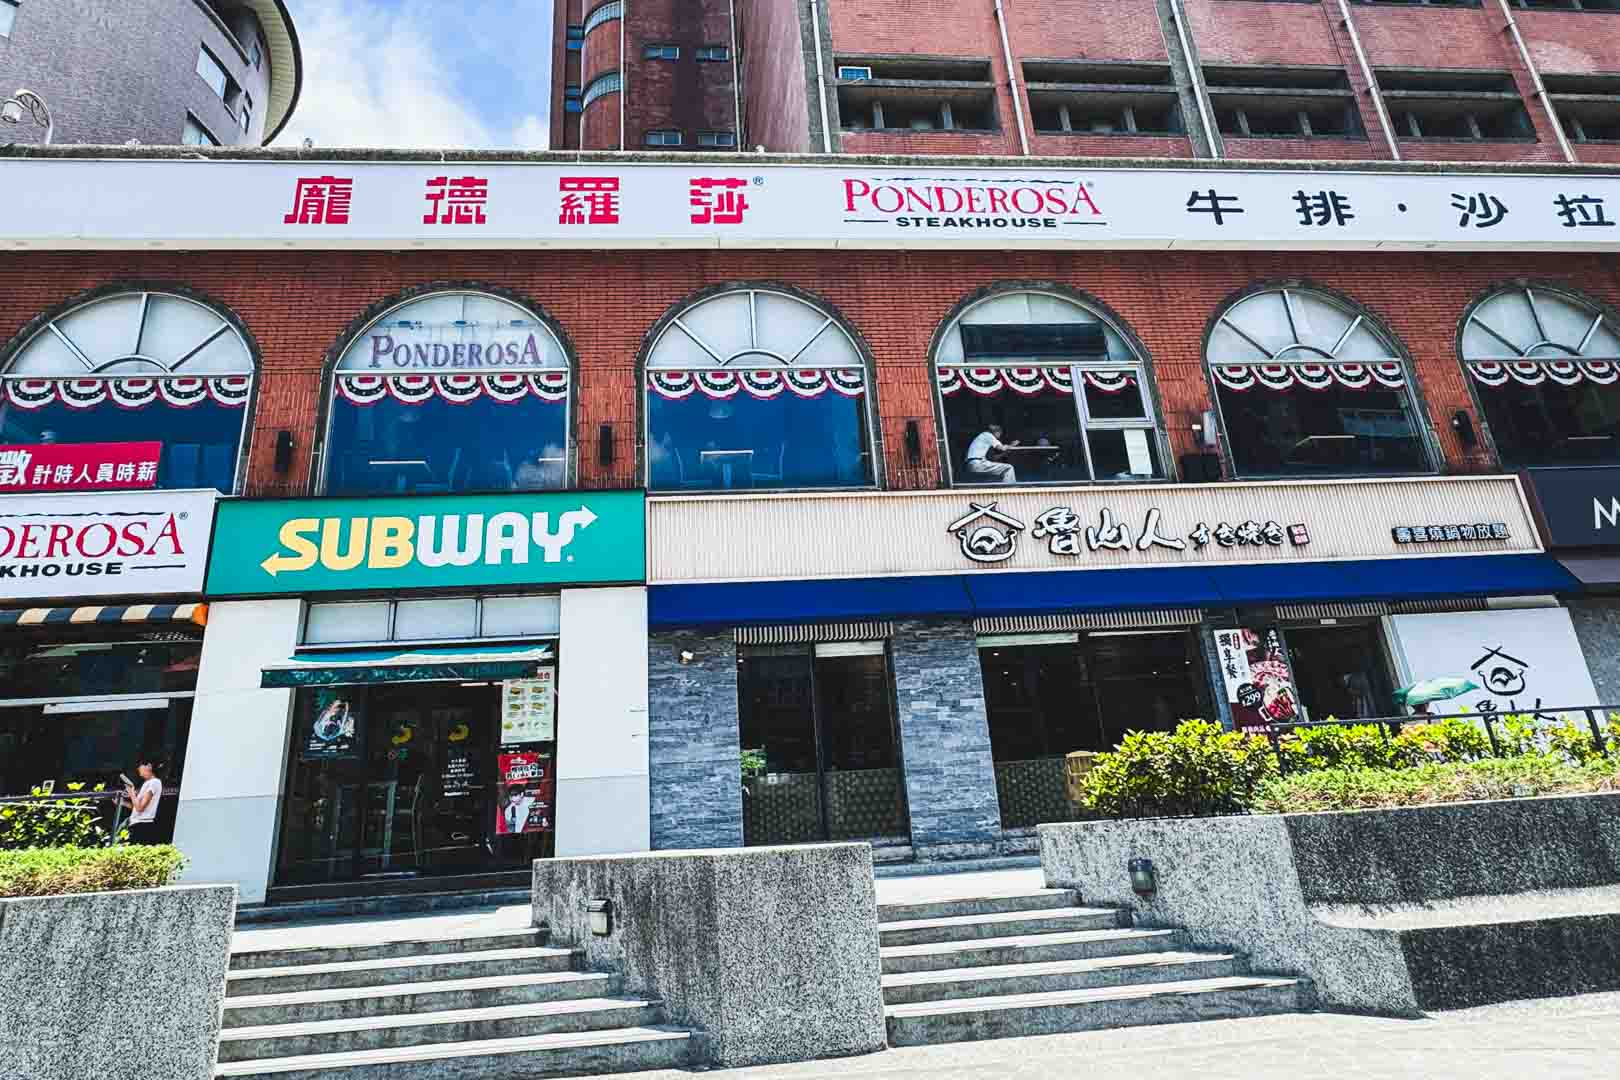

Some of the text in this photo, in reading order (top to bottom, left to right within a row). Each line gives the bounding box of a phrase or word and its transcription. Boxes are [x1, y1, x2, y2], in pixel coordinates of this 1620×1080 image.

[284, 176, 749, 225] 龐德羅莎
[843, 178, 1101, 216] PONDEROSA
[896, 216, 1058, 228] STEAKHOUSE
[369, 332, 543, 368] PONDEROSA
[32, 460, 158, 485] 計時人員時薪
[261, 505, 598, 577] SUBWAY
[1032, 507, 1187, 555] 魯山人
